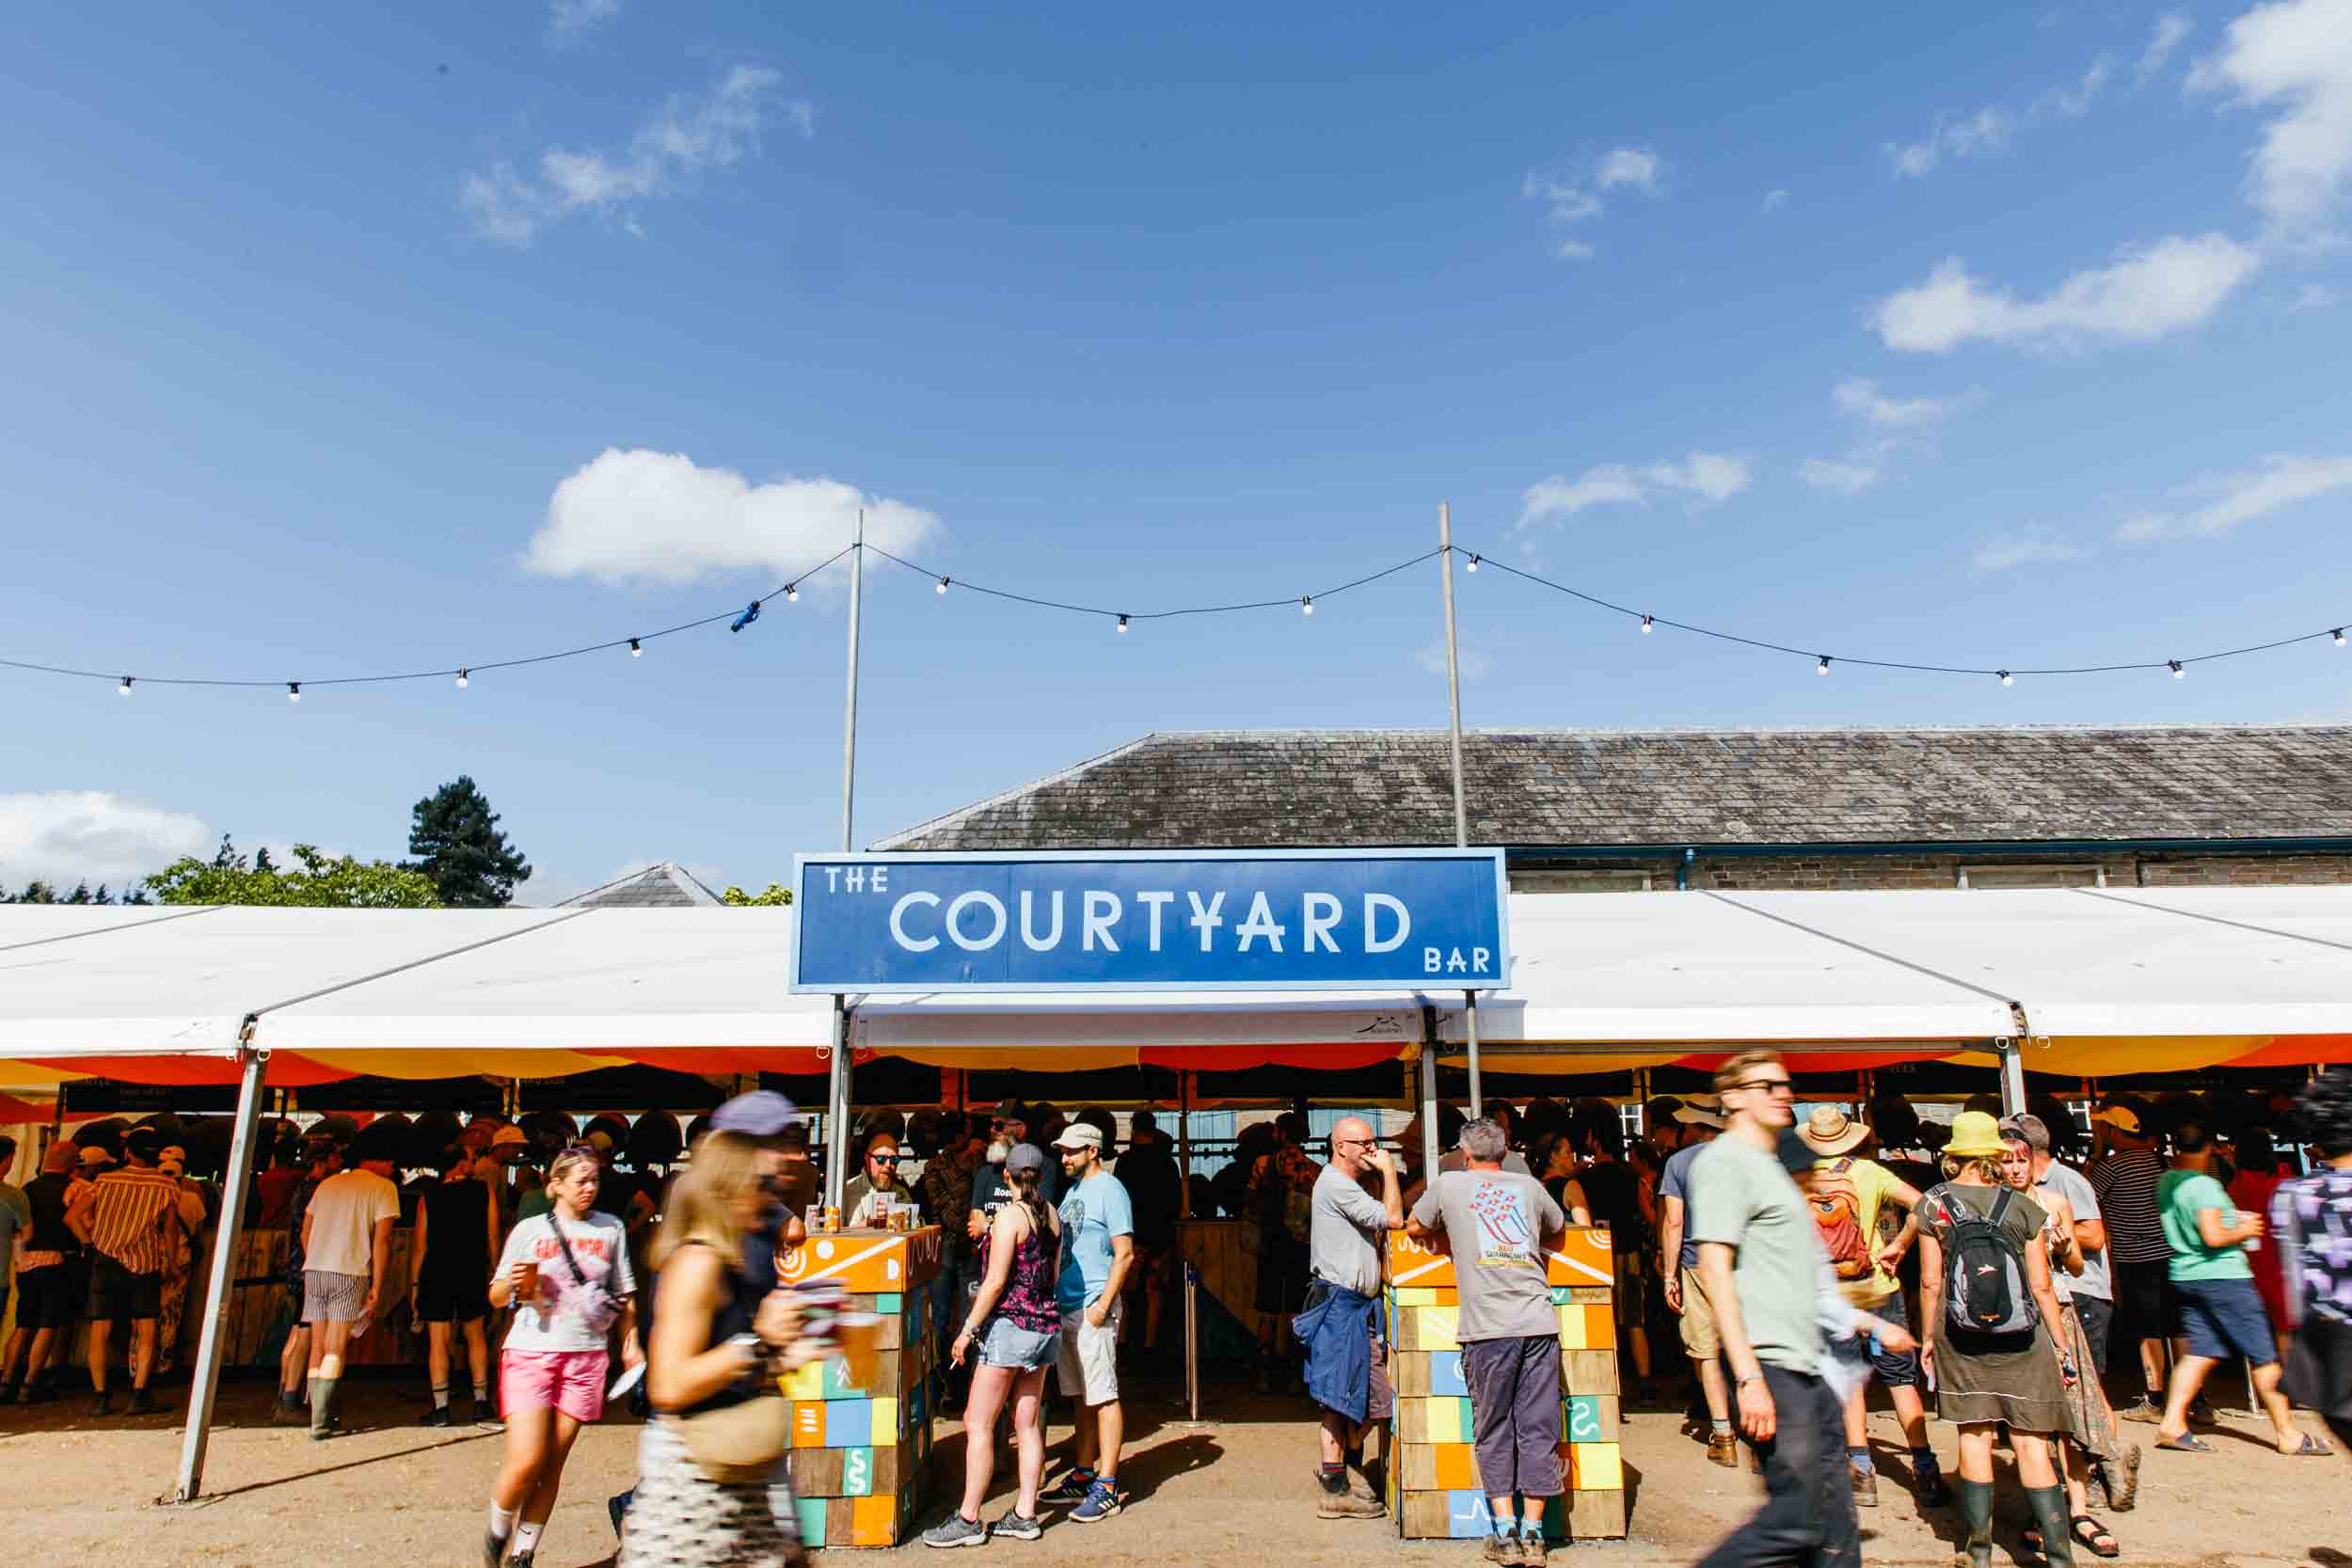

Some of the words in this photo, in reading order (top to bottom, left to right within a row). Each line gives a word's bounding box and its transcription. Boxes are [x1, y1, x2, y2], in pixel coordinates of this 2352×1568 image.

[824, 866, 888, 893] THE
[889, 890, 1411, 954] COURTYARD
[1423, 946, 1490, 973] BAR
